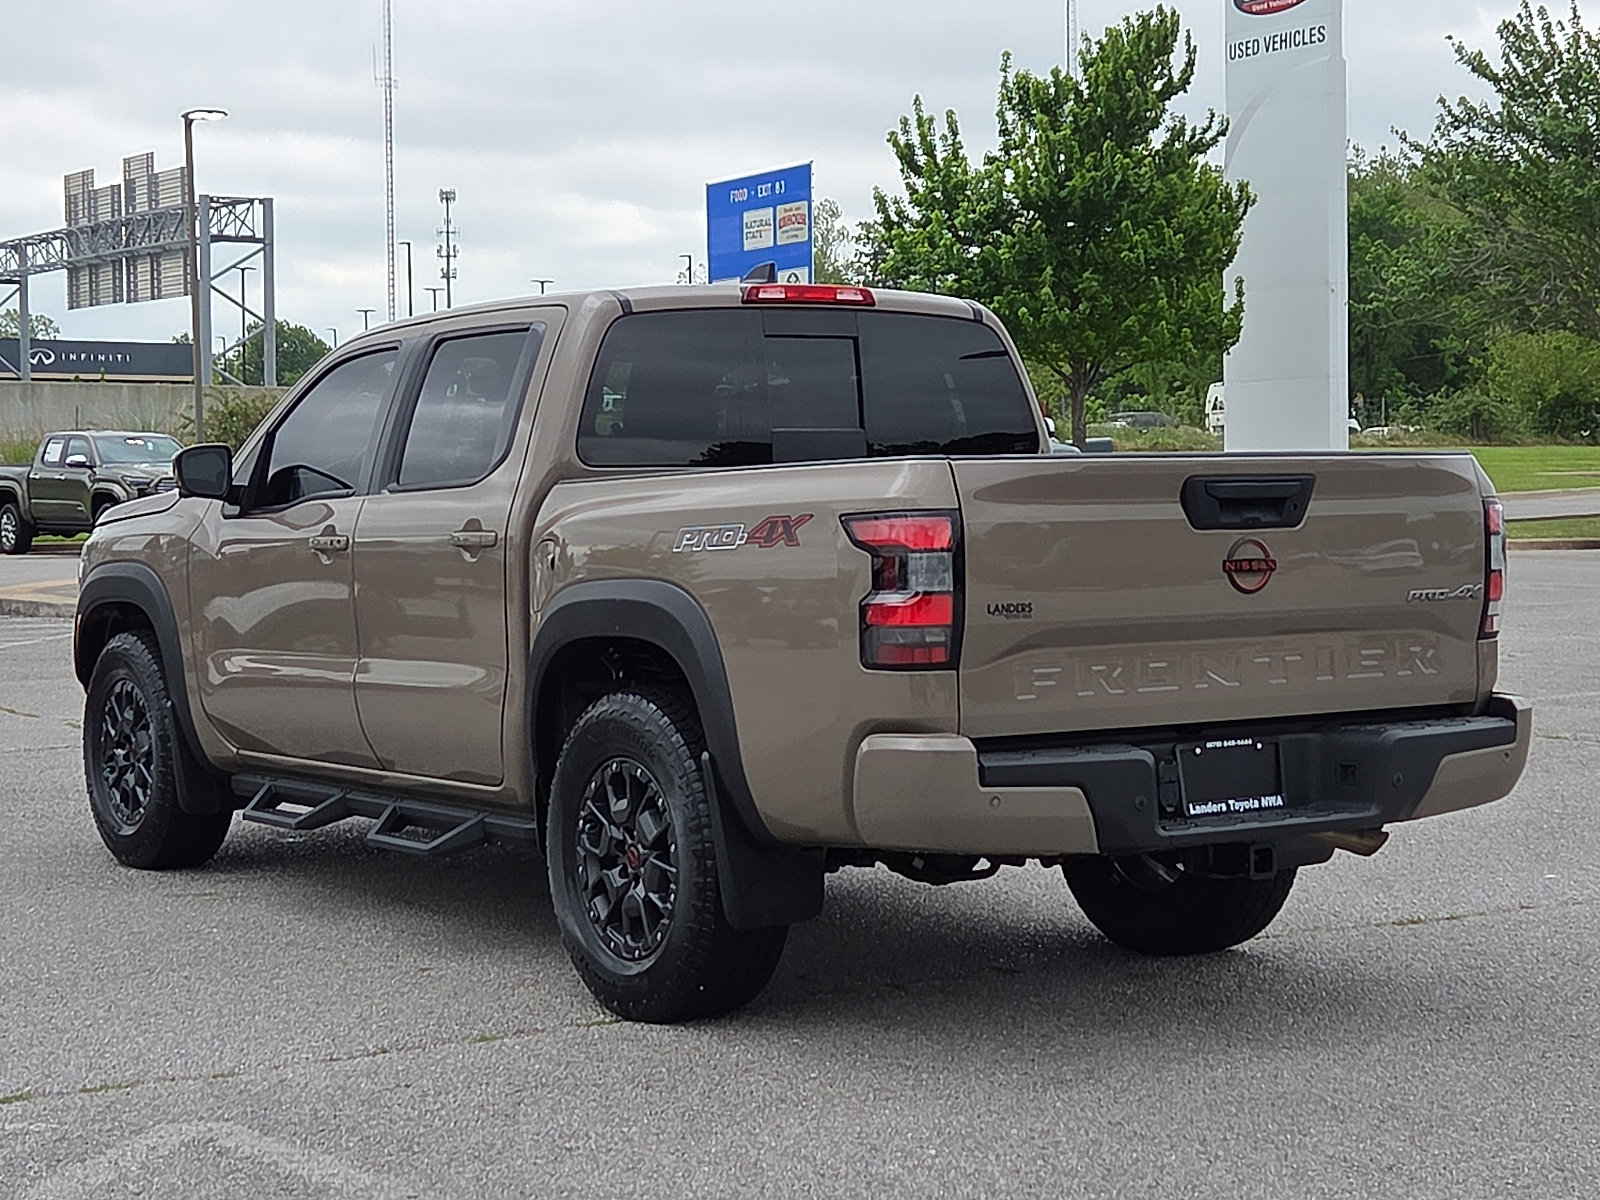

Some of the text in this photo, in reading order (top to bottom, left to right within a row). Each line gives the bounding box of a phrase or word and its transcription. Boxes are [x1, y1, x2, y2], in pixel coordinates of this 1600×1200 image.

[1229, 25, 1326, 60] USED VEHICLES
[730, 187, 748, 203] FOOD
[757, 182, 772, 198] EXIT
[60, 352, 131, 363] INFINITI
[1225, 560, 1276, 571] NISSAN
[987, 602, 1033, 616] LANDERS
[1014, 640, 1439, 700] FRONTIER
[1189, 795, 1283, 815] Landers Toyota NWA
